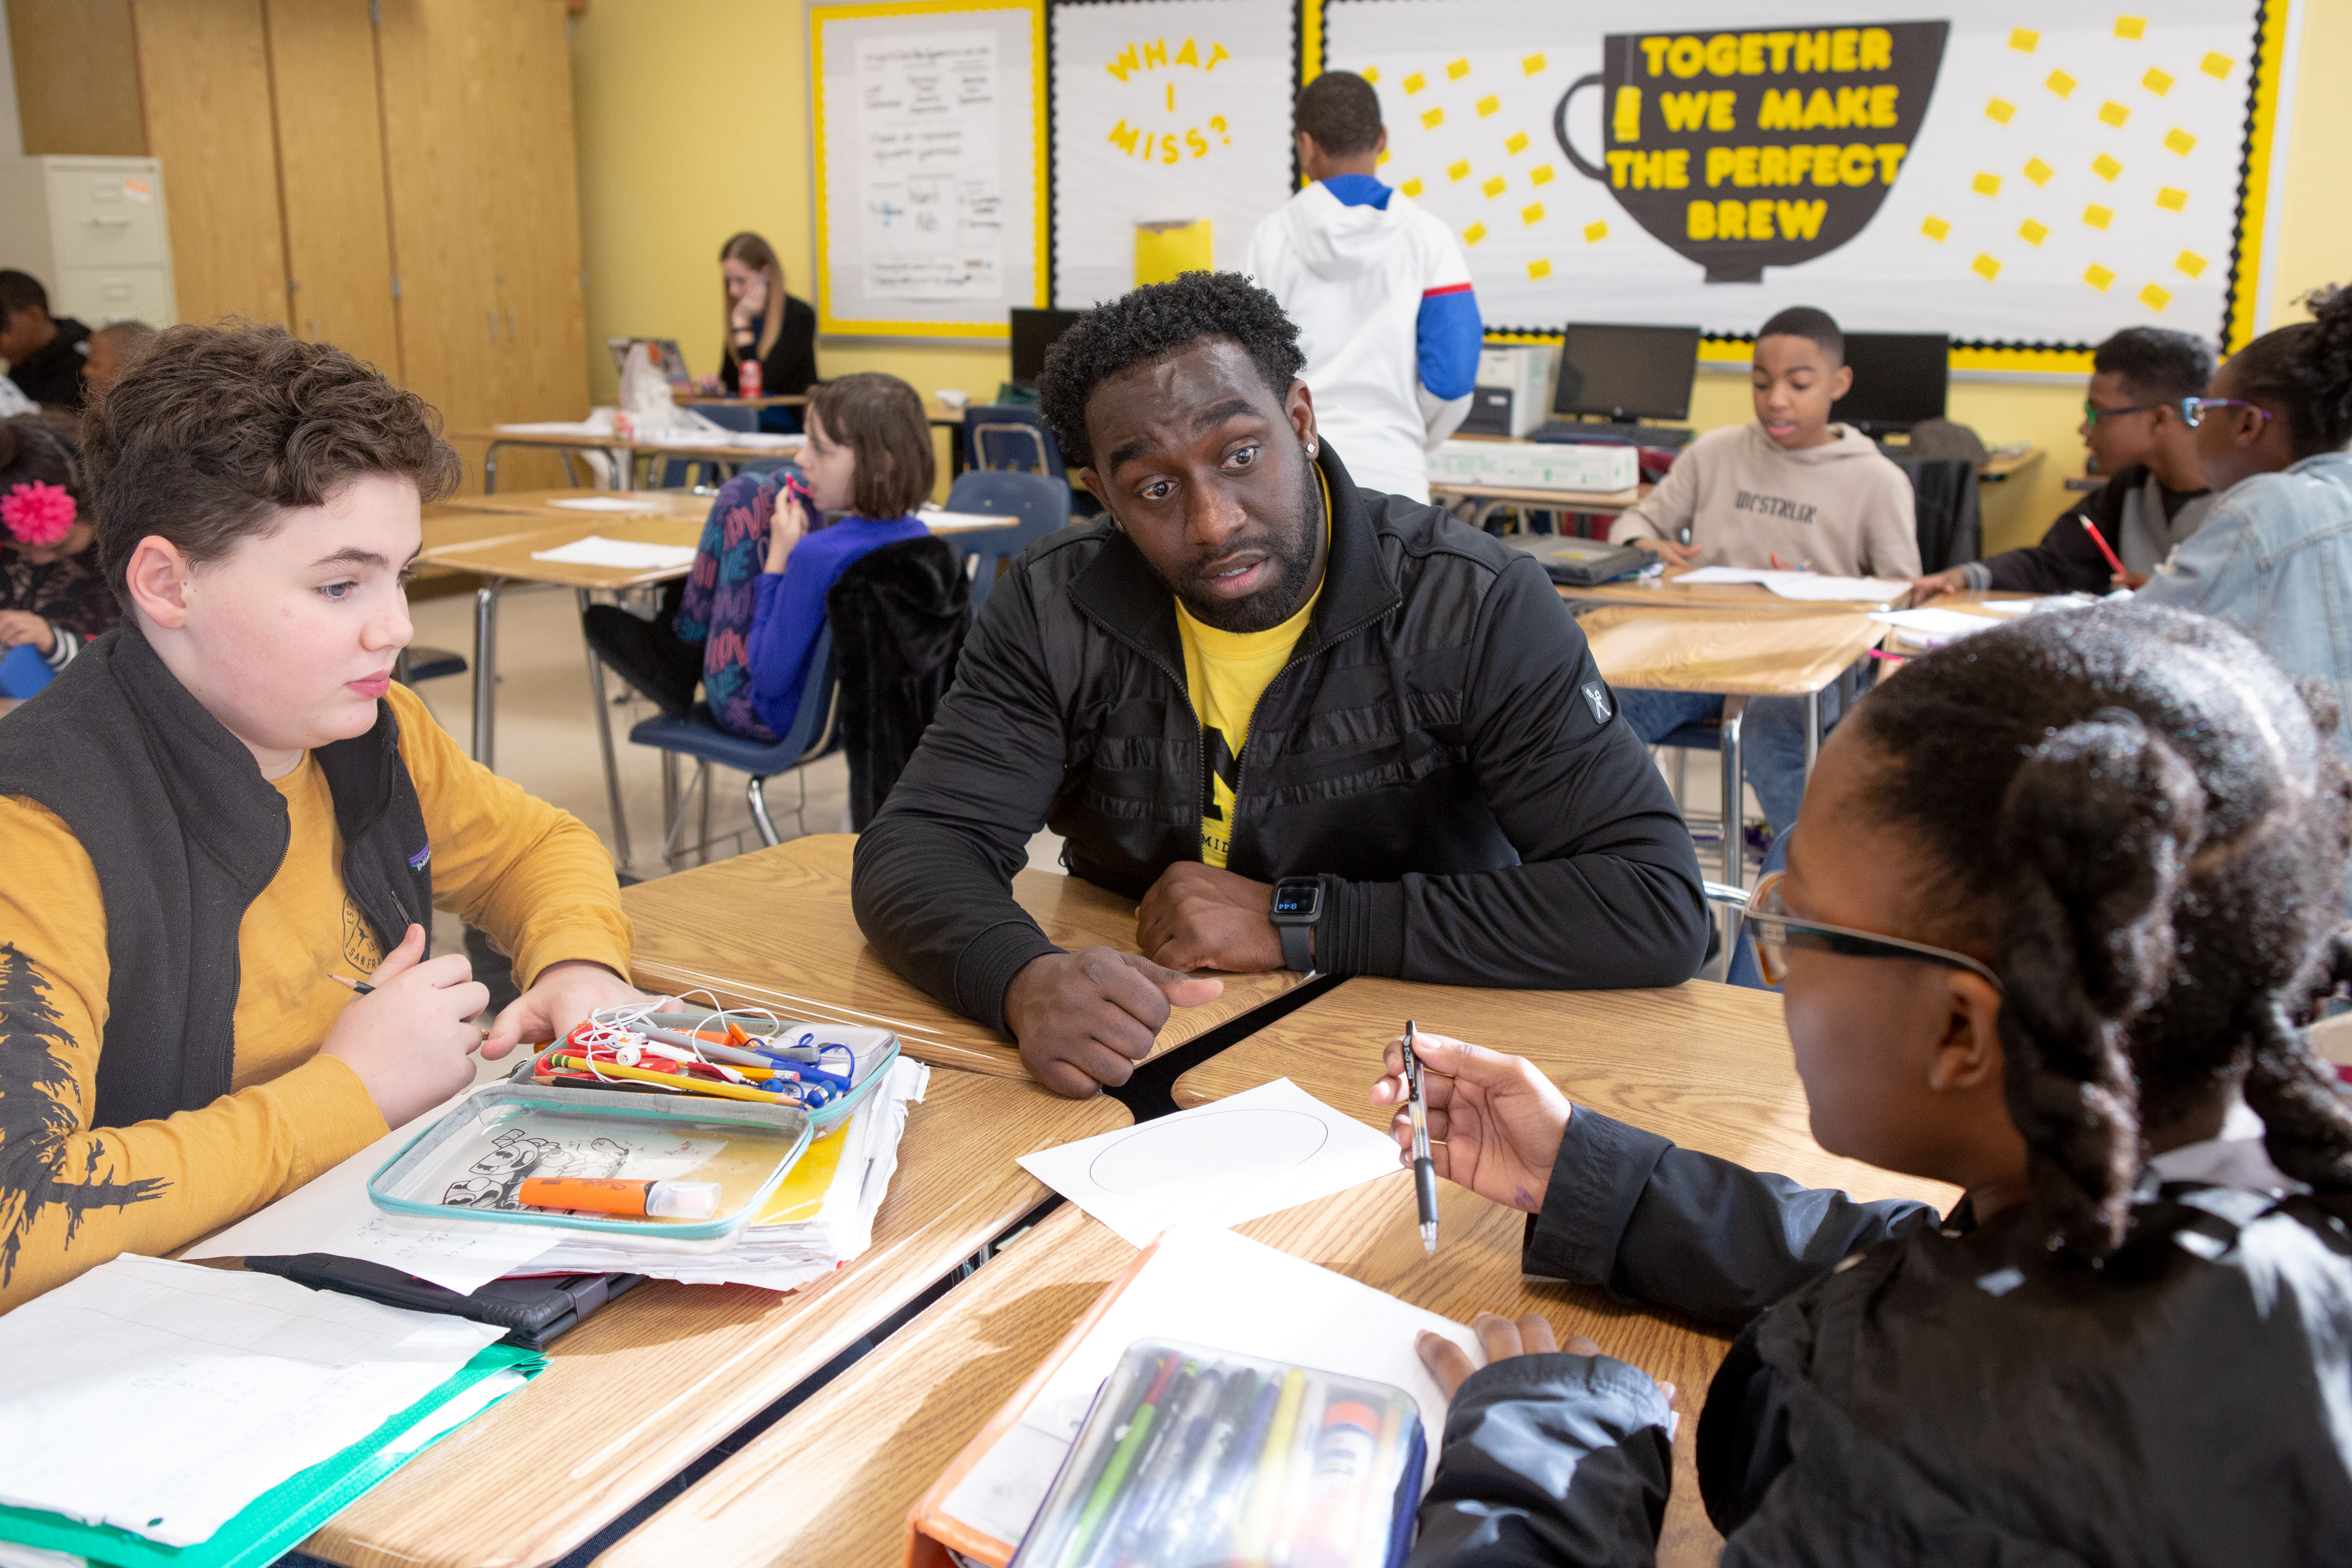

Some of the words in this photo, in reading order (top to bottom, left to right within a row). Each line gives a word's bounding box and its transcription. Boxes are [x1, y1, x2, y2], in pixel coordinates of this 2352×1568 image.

[1106, 37, 1228, 81] WHAT
[1640, 27, 1892, 78] TOGETHER
[1166, 82, 1175, 114] I
[1660, 90, 1737, 132] WE
[1758, 85, 1899, 130] MAKE
[1107, 116, 1230, 164] MISS?
[1605, 149, 1690, 190] THE
[1705, 143, 1907, 188] PERFECT
[1687, 199, 1828, 240] BREW
[349, 947, 366, 967] SAN
